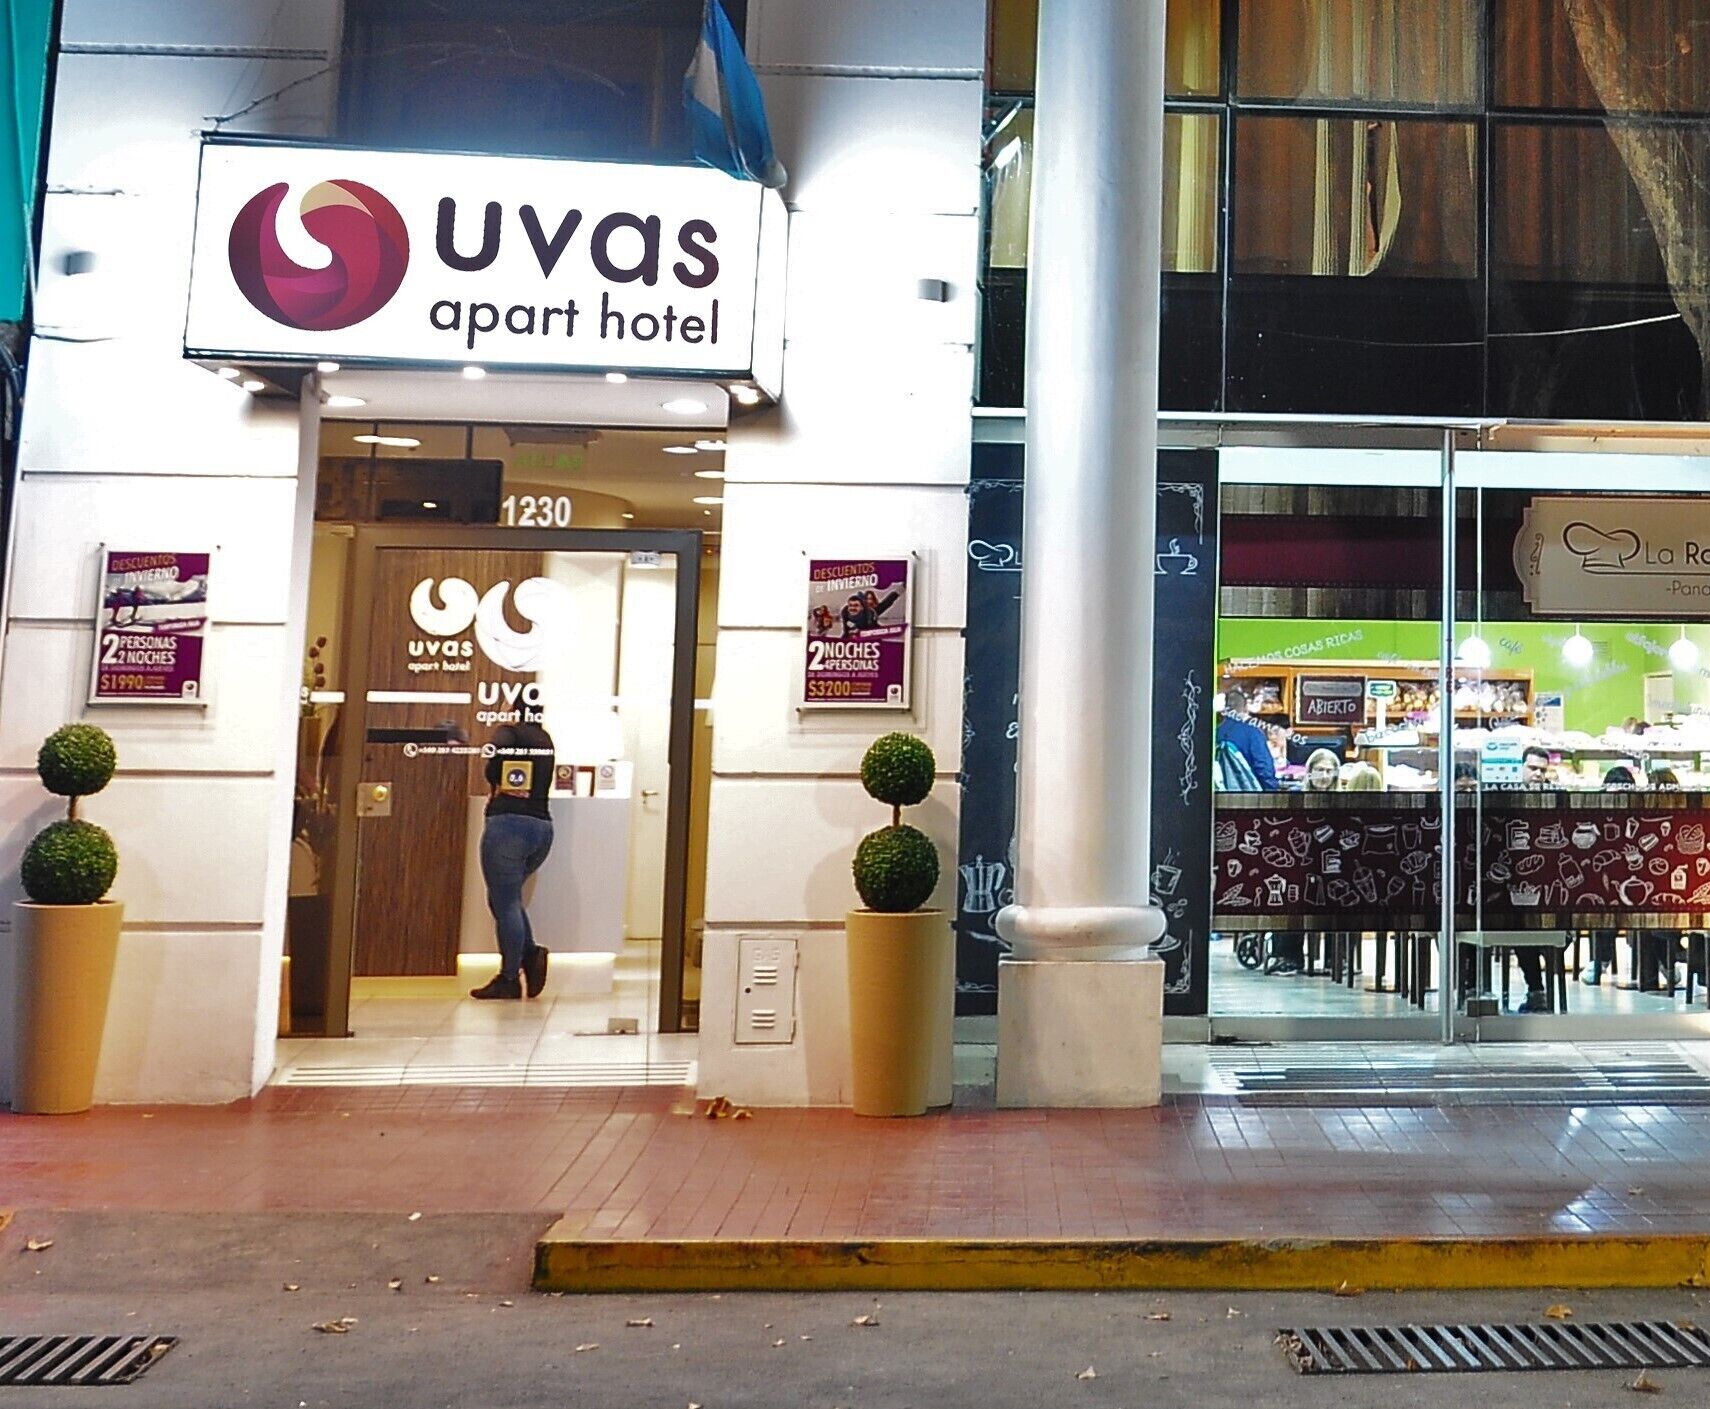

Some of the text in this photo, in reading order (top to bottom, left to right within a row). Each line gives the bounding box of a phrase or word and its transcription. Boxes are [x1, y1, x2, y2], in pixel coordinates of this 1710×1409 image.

[436, 196, 719, 289] uvas
[429, 291, 719, 350] apart hotel
[502, 494, 572, 528] 1230
[1645, 540, 1675, 566] La
[112, 554, 177, 572] DESCUENTOS
[813, 563, 876, 580] DESCUENTOS
[124, 565, 181, 583] INVIERNO
[827, 574, 879, 592] INVIERNO
[101, 633, 178, 664] 2 PERSONAS
[408, 640, 474, 657] uvas
[1283, 639, 1325, 659] COSAS
[1325, 628, 1364, 648] RICAS
[126, 650, 177, 665] NOCHES
[808, 641, 880, 671] 2 NOCHES
[407, 659, 472, 674] apart hotel
[808, 680, 851, 696] $3200
[1307, 698, 1358, 715] ABIERTO
[476, 709, 522, 727] apart
